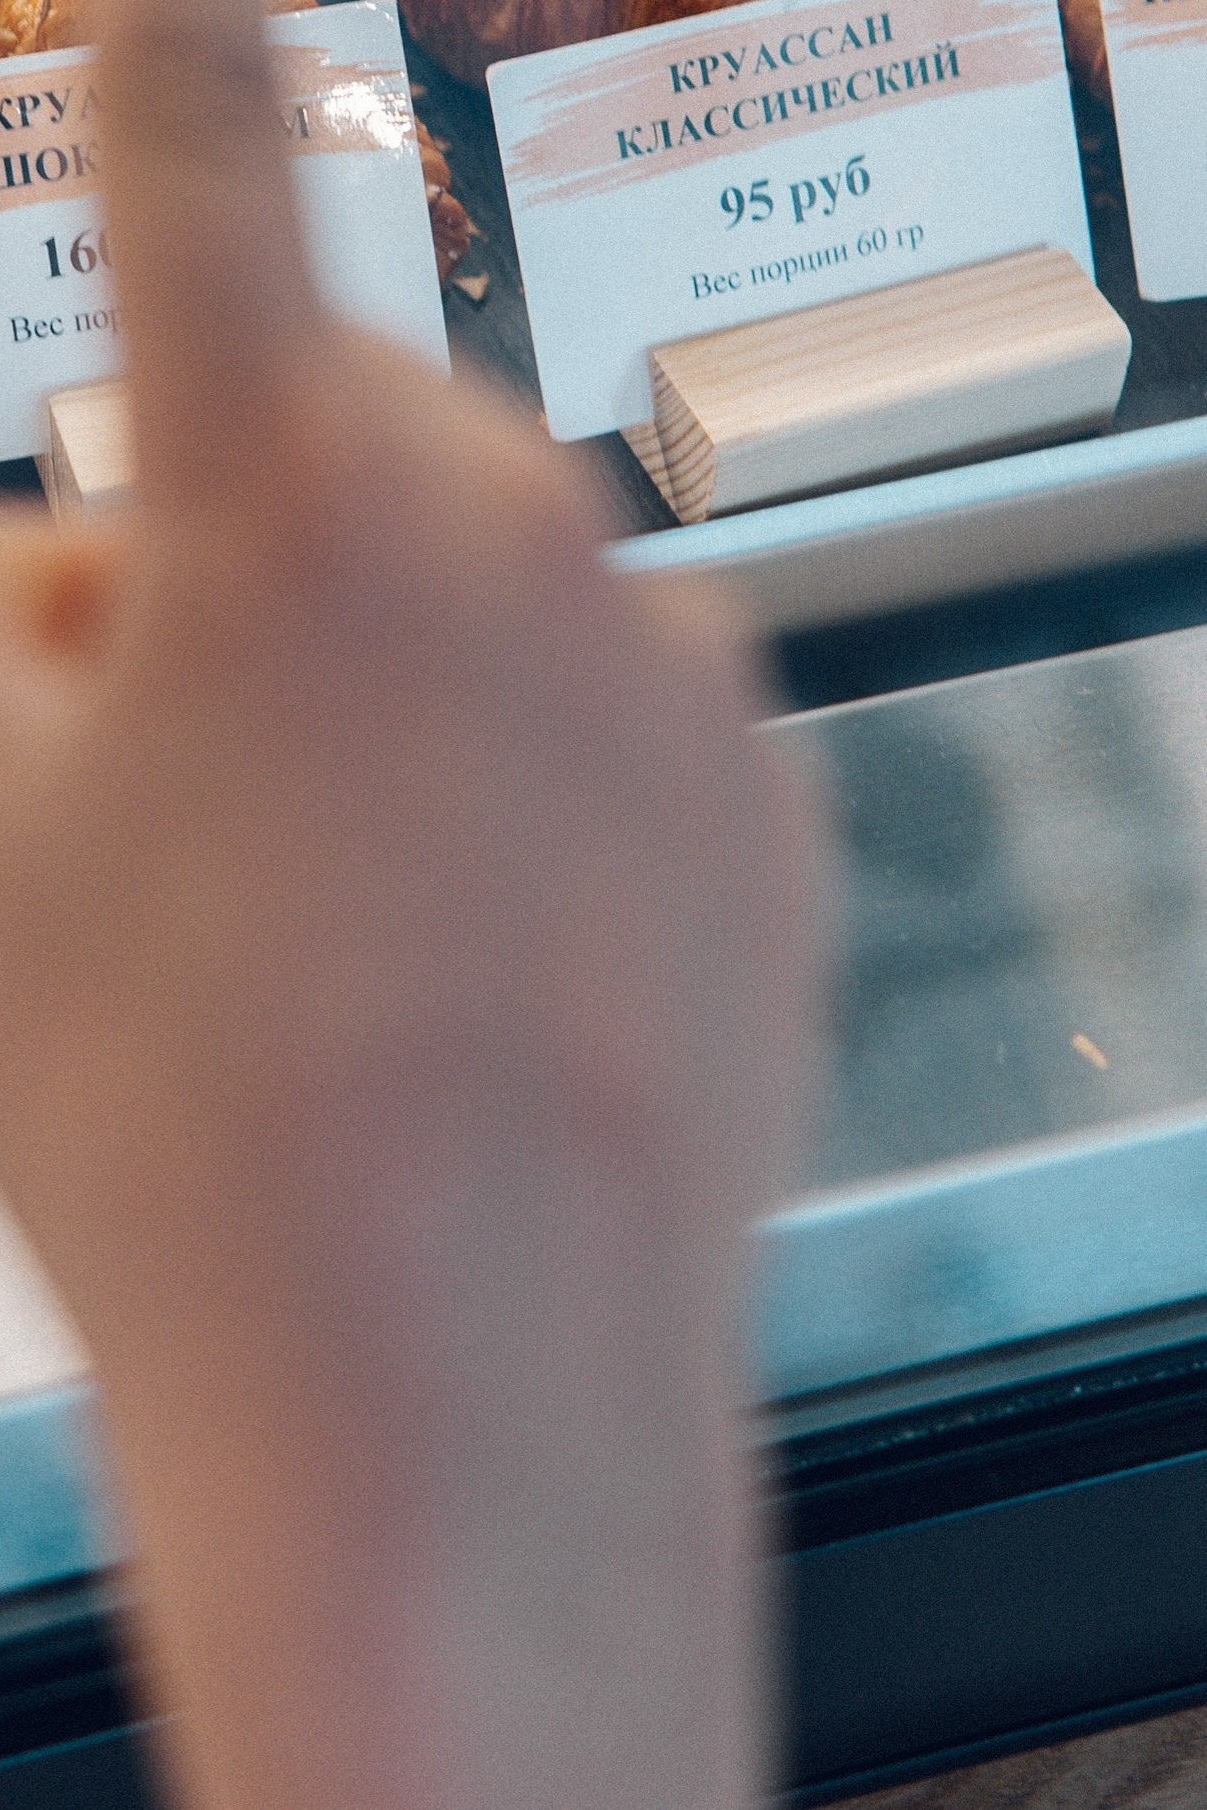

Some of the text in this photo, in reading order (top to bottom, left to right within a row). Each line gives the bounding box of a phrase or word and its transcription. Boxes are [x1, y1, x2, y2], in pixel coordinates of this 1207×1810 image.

[669, 13, 893, 94] КРУАССАН
[615, 41, 961, 160] КЛАССИЧЕСКИЙ
[720, 154, 871, 231] 95 руб
[692, 224, 924, 299] Вес порции 60 гр
[9, 316, 65, 343] Вес
